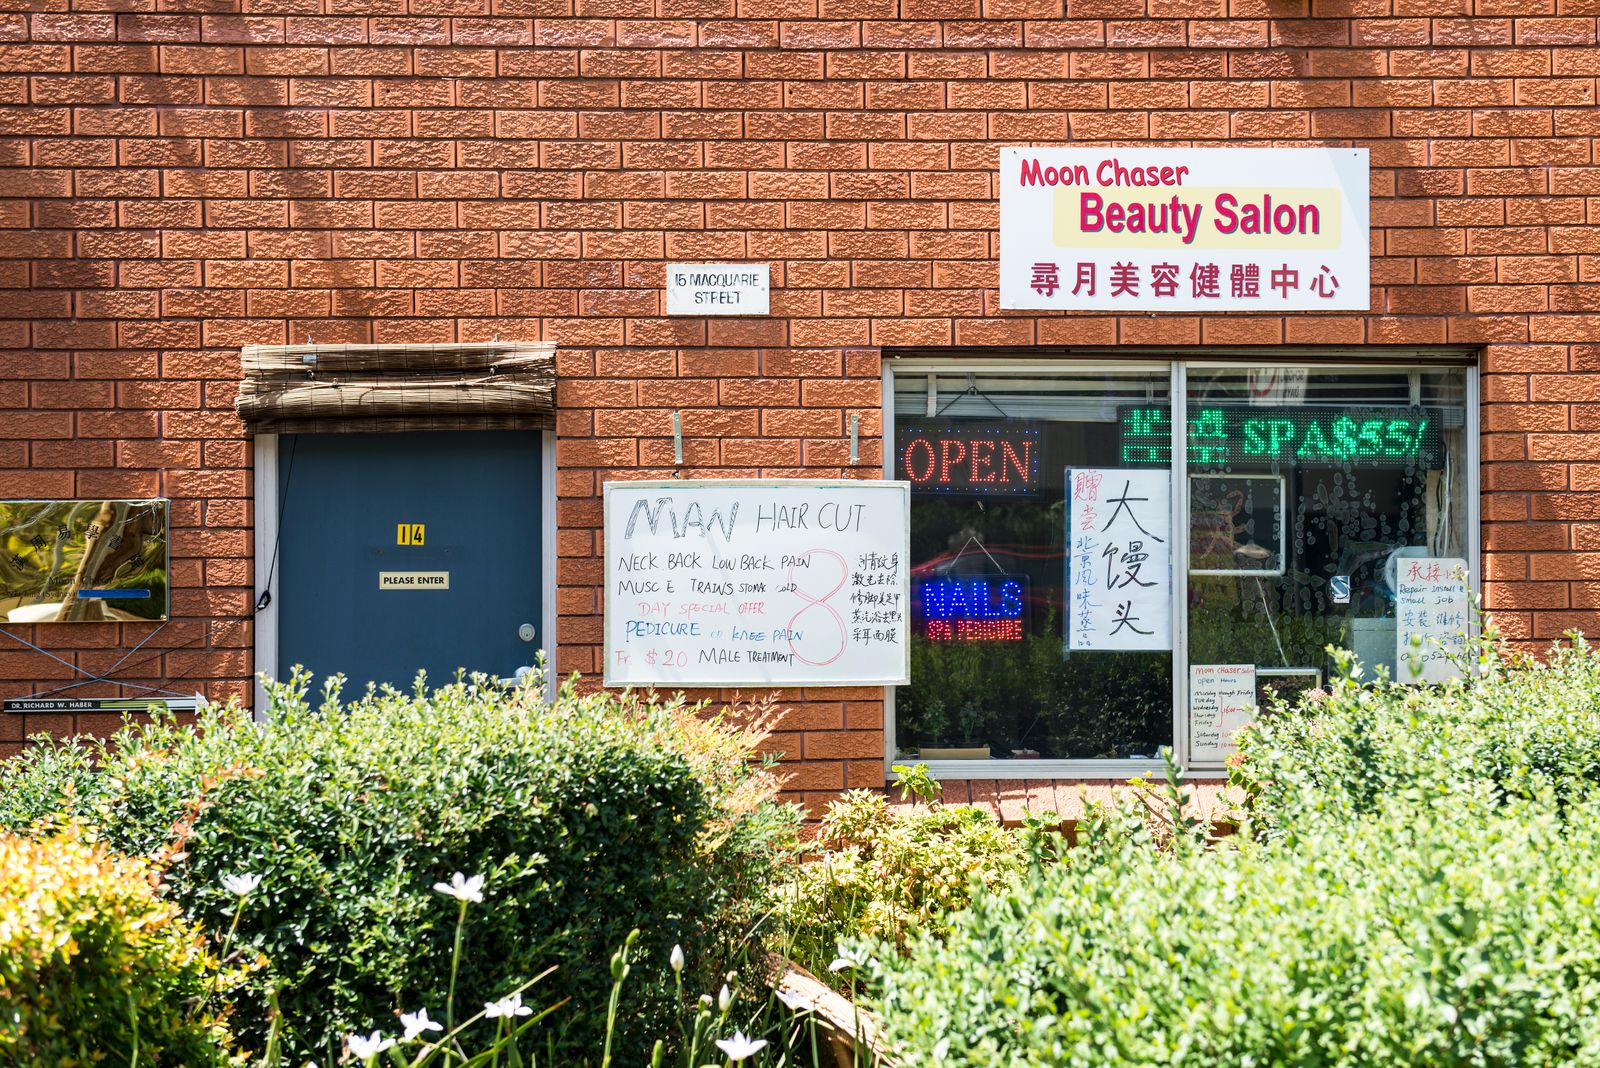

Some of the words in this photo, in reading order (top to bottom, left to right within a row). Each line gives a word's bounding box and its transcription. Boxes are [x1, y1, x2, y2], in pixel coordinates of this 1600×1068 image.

[1020, 158, 1090, 187] Moon
[1096, 158, 1189, 187] Chaser
[1079, 191, 1201, 244] Beauty
[1213, 191, 1320, 235] Salon
[675, 273, 687, 286] 15
[690, 273, 760, 288] MACQUARIE
[1030, 262, 1340, 299] 尋月美容健體中心
[694, 291, 742, 304] STREET
[905, 438, 1032, 482] OPEN
[624, 496, 739, 542] MAN
[756, 502, 809, 533] HAIR
[818, 502, 866, 533] CUT
[402, 526, 422, 543] 14
[618, 552, 658, 571] NECK
[668, 552, 702, 570] BACK
[739, 554, 775, 570] BACK
[781, 555, 810, 569] PAIN
[383, 577, 415, 585] PLEASE
[418, 577, 444, 585] ENTER
[1400, 584, 1427, 597] Repair
[925, 582, 1022, 616] NAILS
[1434, 596, 1454, 605] job
[638, 602, 671, 618] DAY
[680, 602, 730, 620] SPECIAL
[738, 601, 766, 615] OFFER
[625, 620, 702, 642] PEDICURE
[773, 628, 804, 644] PAIN
[928, 620, 951, 640] SPA
[957, 620, 1022, 640] PEDICURE
[698, 647, 741, 665] MALE
[746, 650, 796, 667] TREATMENT
